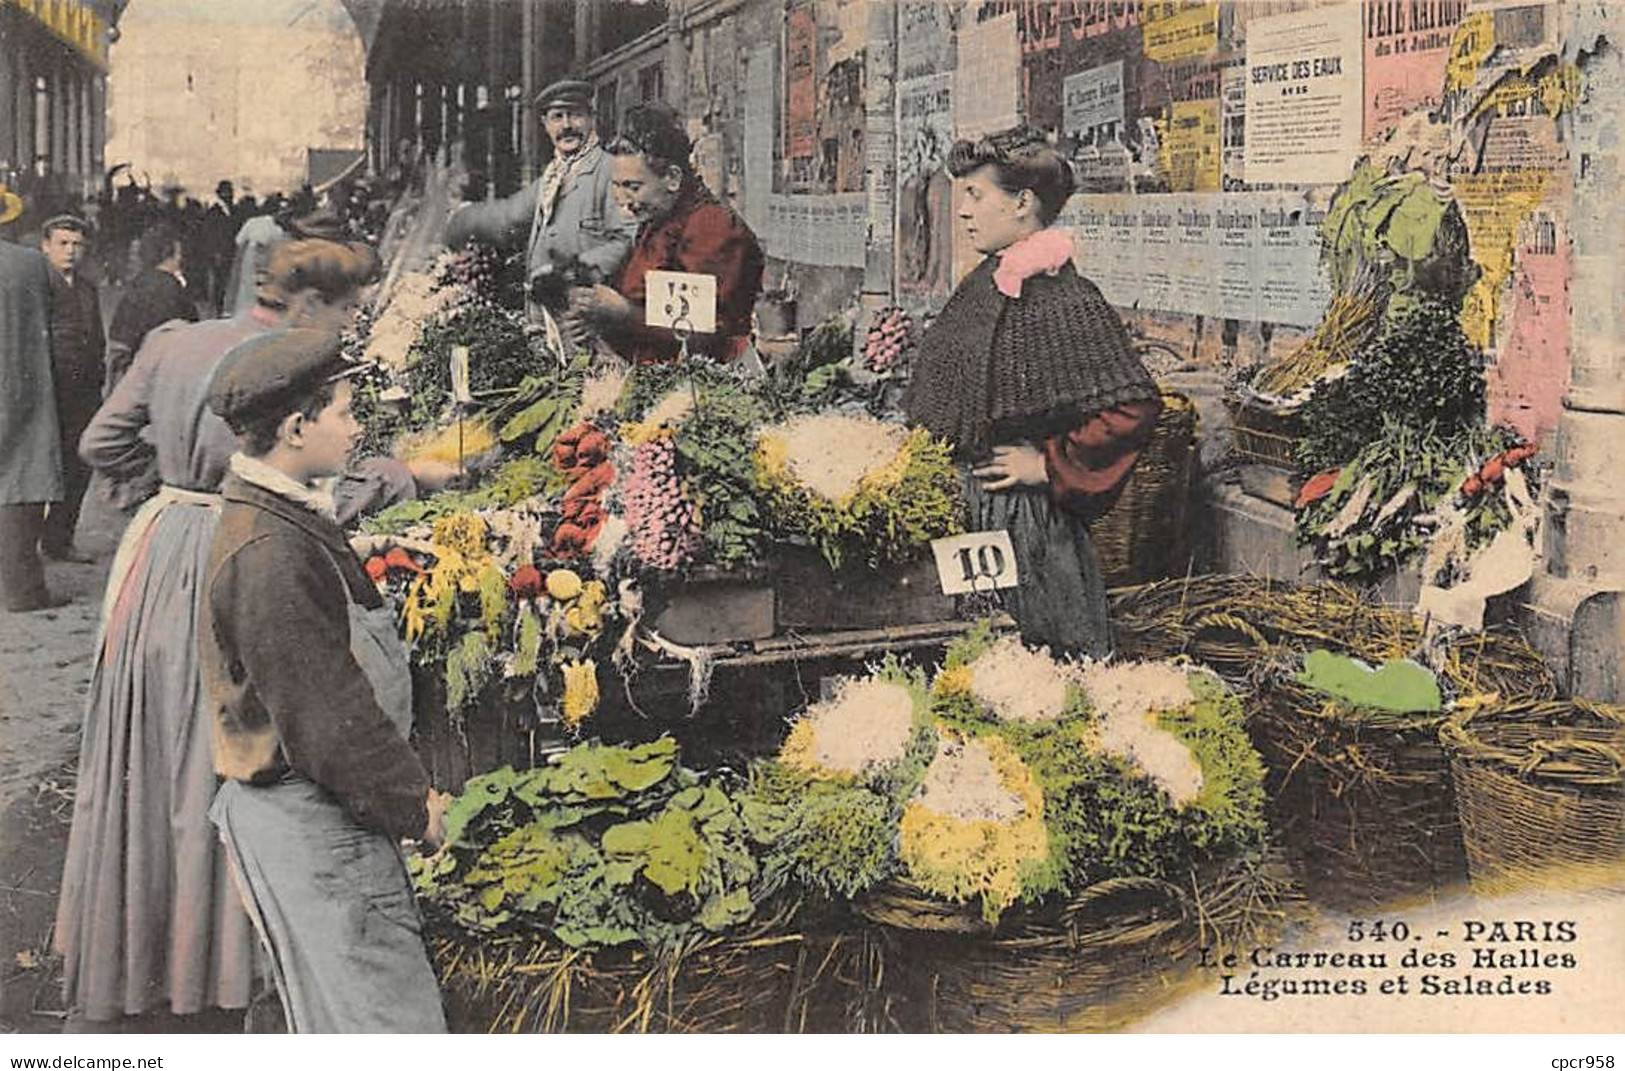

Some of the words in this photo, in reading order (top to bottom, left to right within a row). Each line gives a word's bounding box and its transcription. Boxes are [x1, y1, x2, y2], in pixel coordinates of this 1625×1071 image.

[1252, 62, 1288, 84] SERVICE
[1292, 59, 1310, 79] DES
[1314, 57, 1342, 77] EAUX
[1281, 85, 1308, 96] AVIS
[953, 545, 1005, 581] 10
